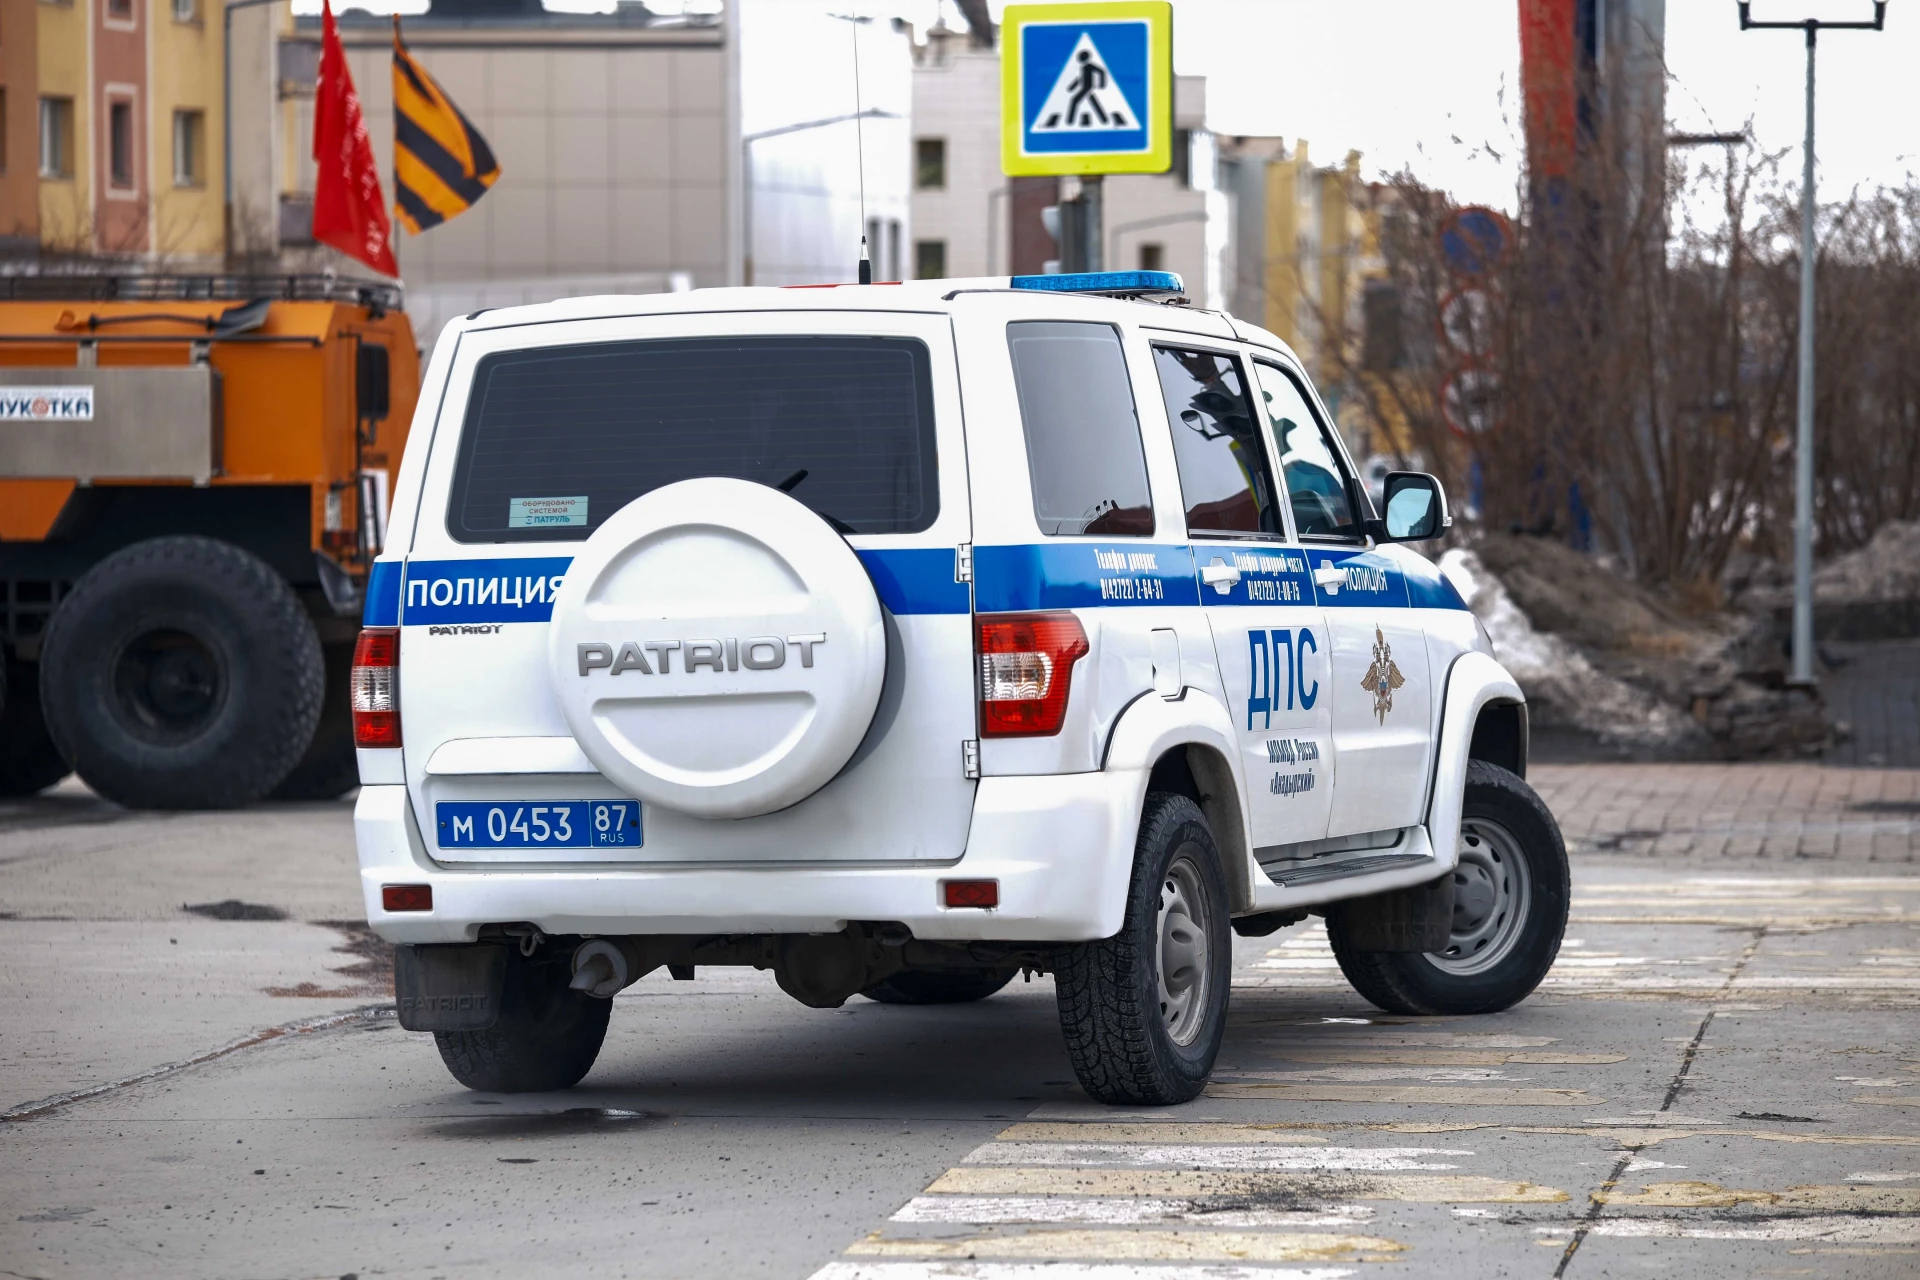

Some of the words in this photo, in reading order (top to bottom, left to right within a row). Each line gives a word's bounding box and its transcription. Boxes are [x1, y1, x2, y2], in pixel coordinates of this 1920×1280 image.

[0, 397, 90, 418] УКОТКА
[522, 499, 576, 508] ОБОРУДОВАНО
[528, 507, 568, 515] СИСТЕМОЙ
[534, 515, 571, 524] ПАТРУЛЬ
[1099, 578, 1135, 600] 8(42722)
[1135, 578, 1164, 600] 2-64-31
[1343, 566, 1388, 595] ПОЛИЦИЯ
[407, 575, 565, 609] ПОЛИЦИЯ
[429, 624, 503, 637] PATRIOT
[576, 632, 827, 677] PATRIOT
[1247, 627, 1319, 731] ДПС
[1293, 738, 1320, 762] России
[487, 807, 573, 842] 0453
[594, 805, 627, 832] 87
[600, 833, 625, 843] RUS
[402, 994, 488, 1011] PATRIOT
